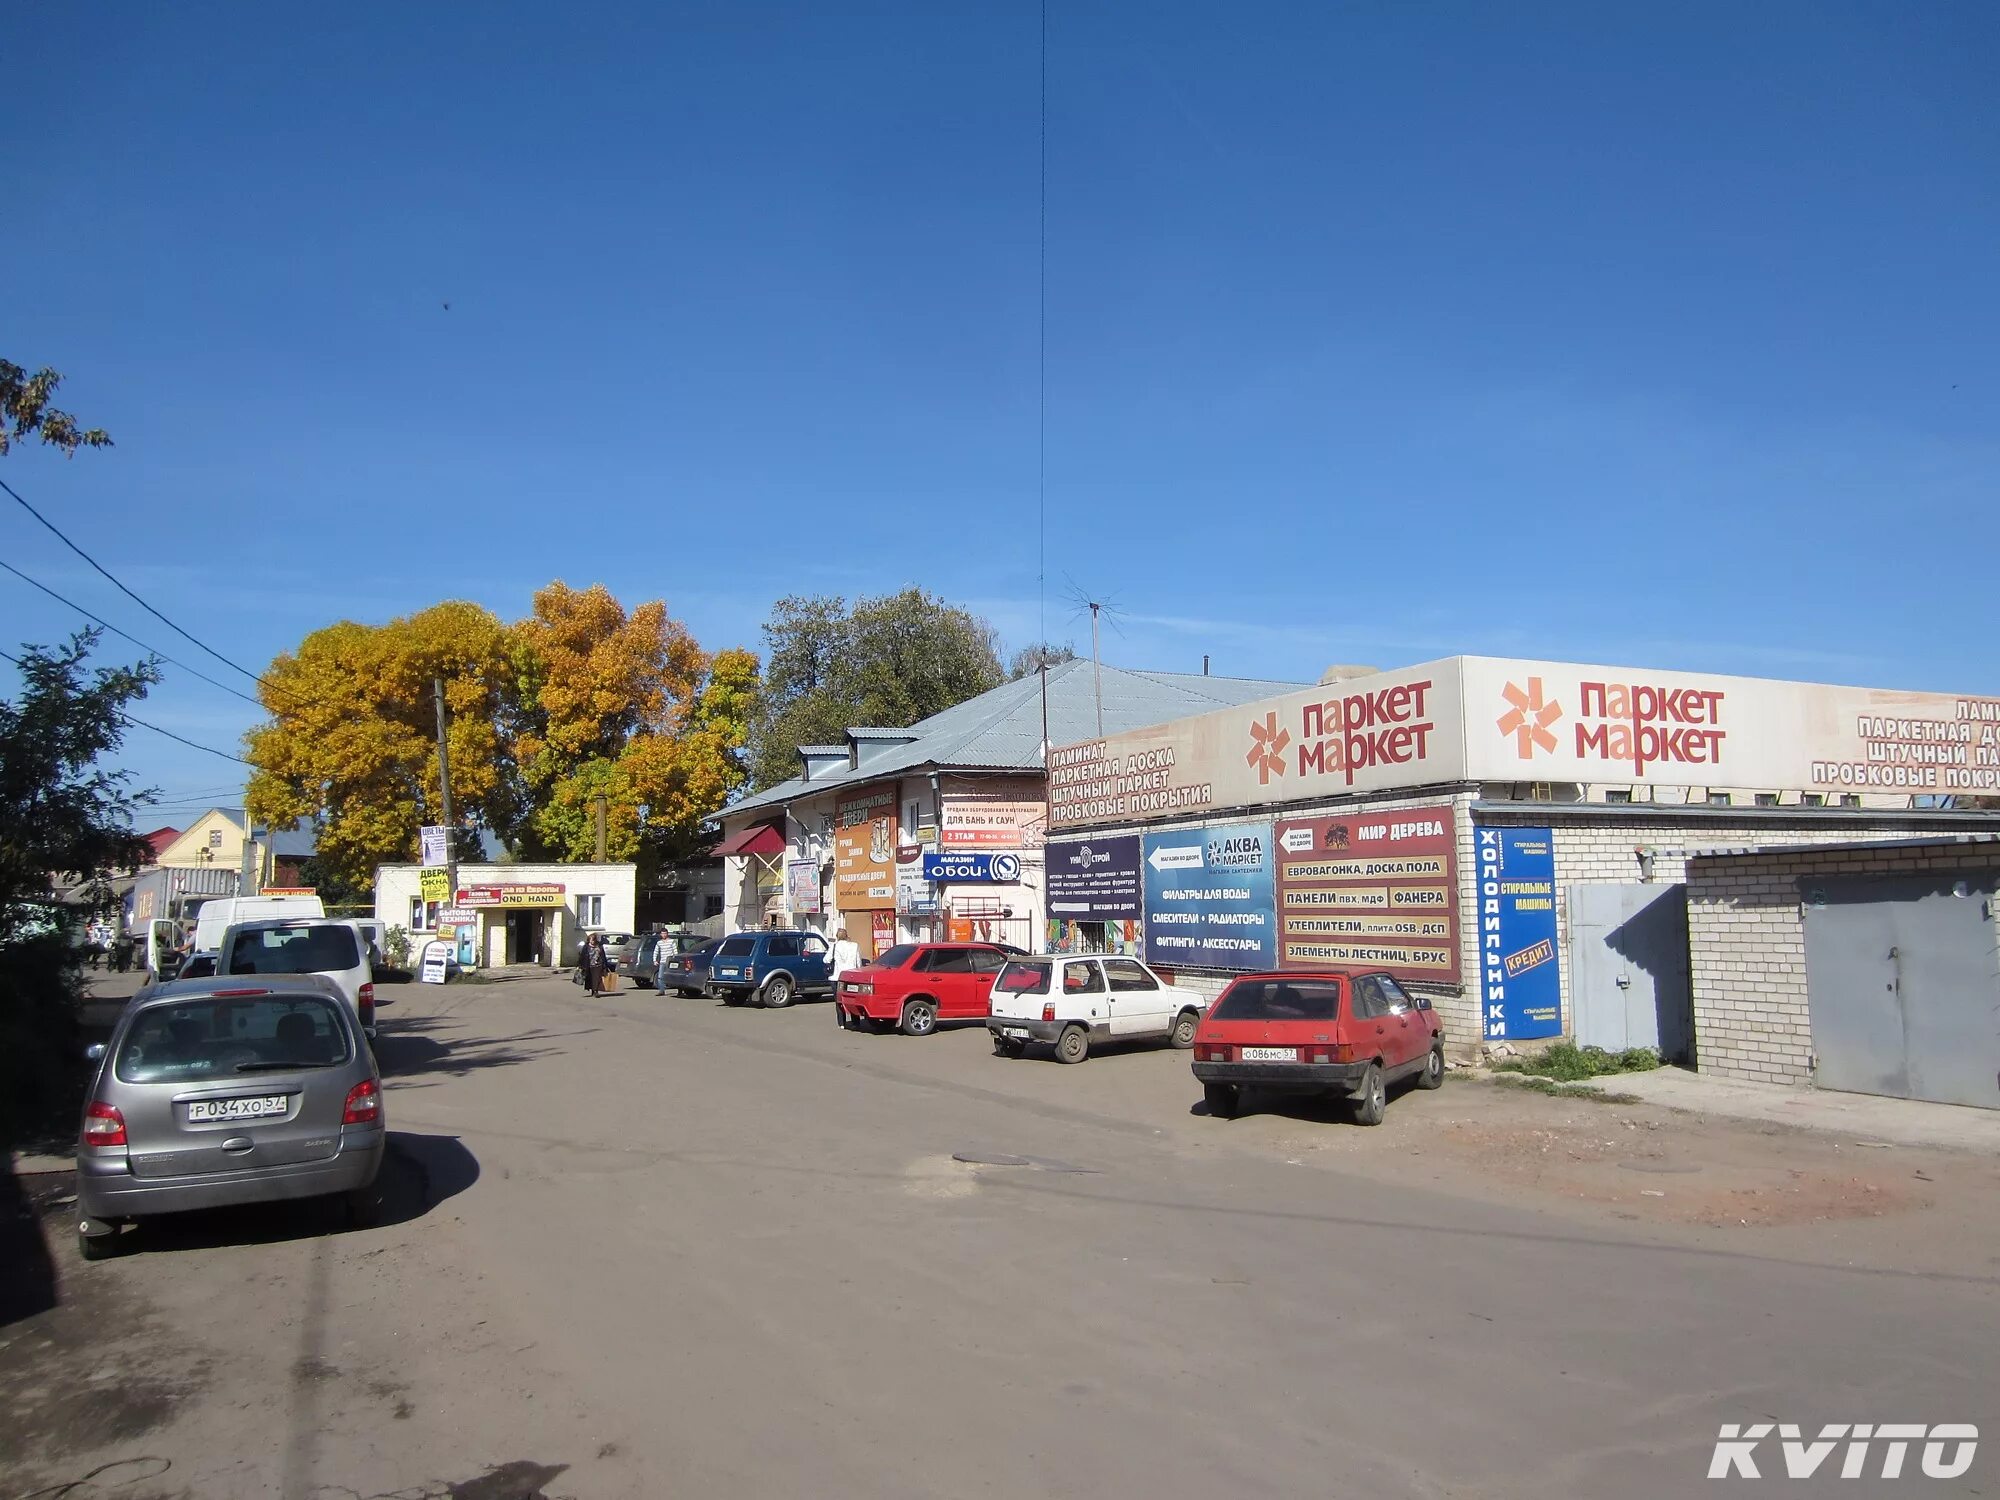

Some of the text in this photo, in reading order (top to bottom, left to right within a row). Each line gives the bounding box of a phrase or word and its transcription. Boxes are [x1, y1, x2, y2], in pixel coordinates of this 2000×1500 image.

[1859, 717, 1971, 742] ПАРКЕТНАЯ
[1051, 742, 1106, 768] ЛАМИНАТ
[1867, 741, 1966, 765] ШТУЧНЫЙ
[1052, 748, 1175, 785] ПАРКЕТНАЯ ДОСКА
[1812, 762, 1936, 787] ПРОБКОВЫЕ
[1052, 778, 1111, 803] ШТУЧНЫЙ
[1117, 769, 1169, 794] ПАРКЕТ
[1053, 784, 1212, 822] ПРОБКОВЫЕ ПОКРЫТИЯ
[843, 808, 868, 830] ДВЕРИ
[947, 816, 1015, 825] ДЛЯ БАНЬ И САУН
[422, 827, 445, 835] ЦВЕТЫ
[954, 832, 976, 840] ЭТАЖ
[1289, 832, 1311, 840] МАГАЗИН
[1358, 821, 1444, 841] МИР ДЕРЕВА
[1224, 837, 1262, 853] АКВА
[1091, 851, 1111, 863] СТРОЙ
[1223, 854, 1263, 866] МАРКЕТ
[420, 868, 448, 879] ДВЕРИ
[1288, 861, 1440, 877] ЕВРОВАГОНКА, ДОСКА ПОЛА
[1162, 889, 1250, 900] ФИЛЬТРЫ ДЛЯ ВОДЫ
[1501, 882, 1552, 895] СТИРАЛЬНЫЕ
[1287, 893, 1385, 904] ПАНЕЛИ ПВХ, МДФ
[1394, 892, 1445, 904] ФАНЕРА
[1515, 898, 1552, 911] МАШИНЫ
[1120, 903, 1136, 911] ДВОРЕ
[1152, 913, 1265, 925] СМЕСИТЕЛИ РАДИАТОРЫ
[1288, 920, 1365, 933] УТЕПЛИТЕЛИ,
[1395, 923, 1420, 934] OSB,
[1422, 924, 1445, 935] ДСП
[1480, 831, 1506, 1037] ХОЛОДИЛЬНИКИ
[1156, 936, 1261, 951] ФИТИНГИ АКСЕССУАРЫ
[1289, 946, 1446, 963] ЭЛЕМЕНТЫ ЛЕСТНИЦ, БРУС
[1507, 943, 1549, 971] КРЕДИТ
[1284, 1049, 1294, 1057] 57
[265, 1096, 281, 1107] 57
